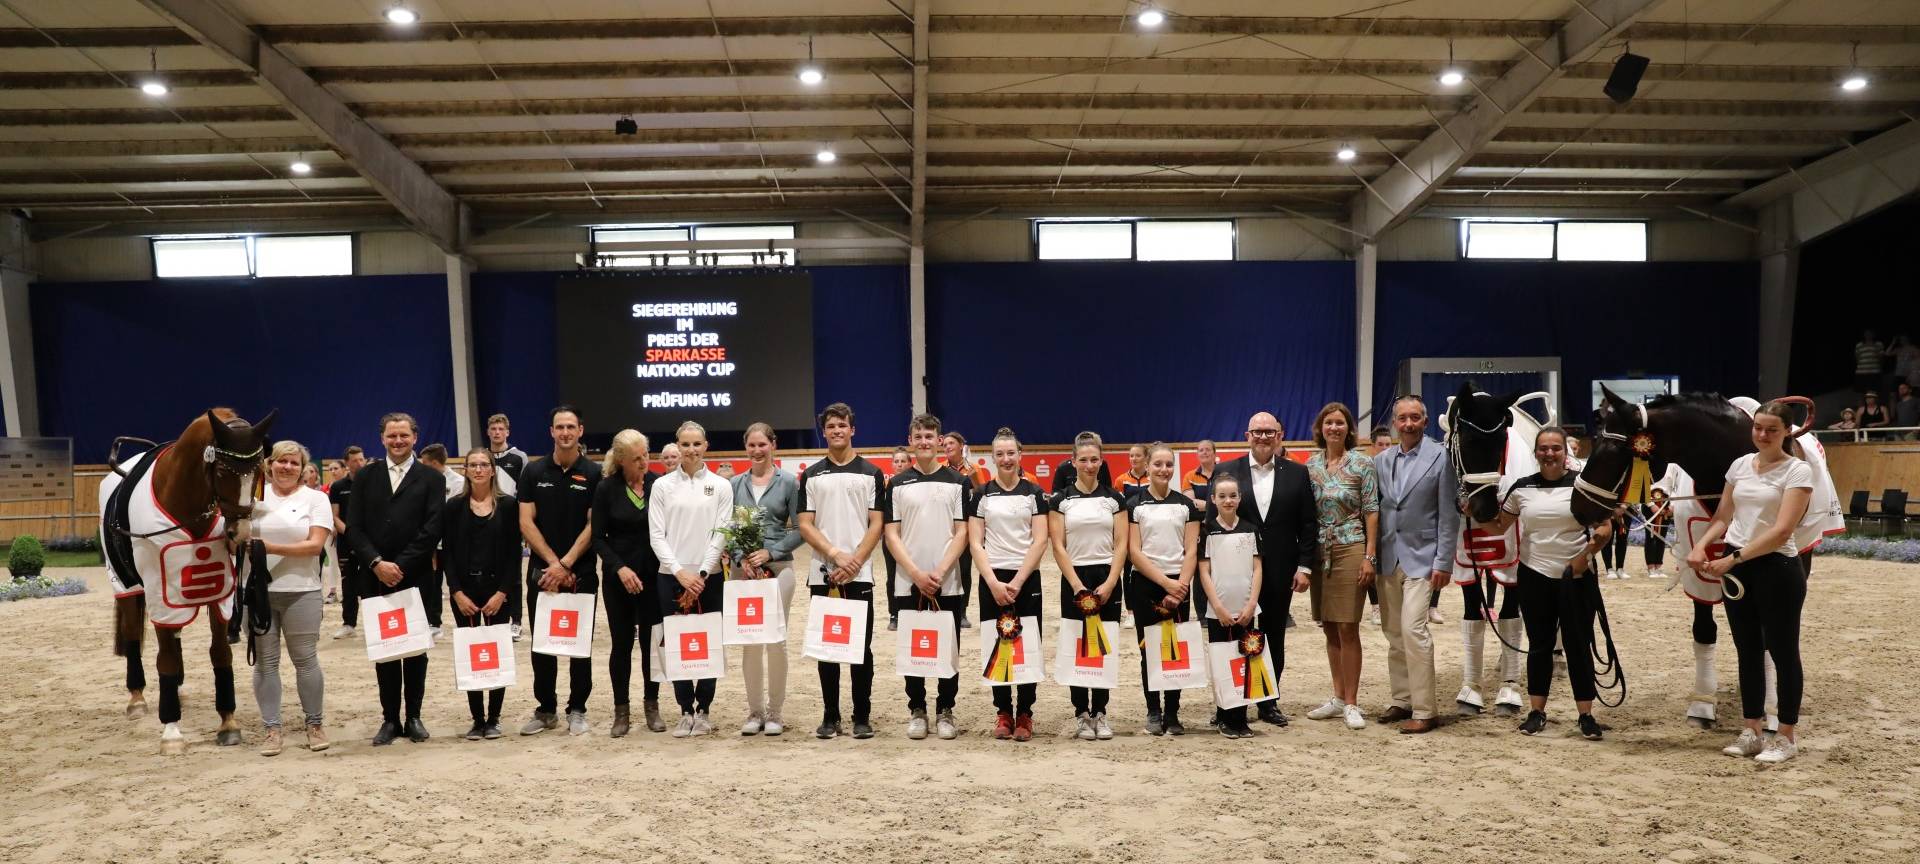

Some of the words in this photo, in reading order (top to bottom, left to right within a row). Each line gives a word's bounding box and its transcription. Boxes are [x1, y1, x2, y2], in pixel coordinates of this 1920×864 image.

[632, 302, 738, 318] SIEGEREHRUNG
[676, 318, 694, 331] IM
[647, 334, 687, 347] PREIS
[690, 333, 719, 346] DER
[646, 348, 726, 362] SPARKASSE
[637, 364, 704, 378] NATIONS'
[707, 363, 735, 376] CUP
[642, 391, 708, 408] PRÜFUNG
[712, 393, 731, 407] V6
